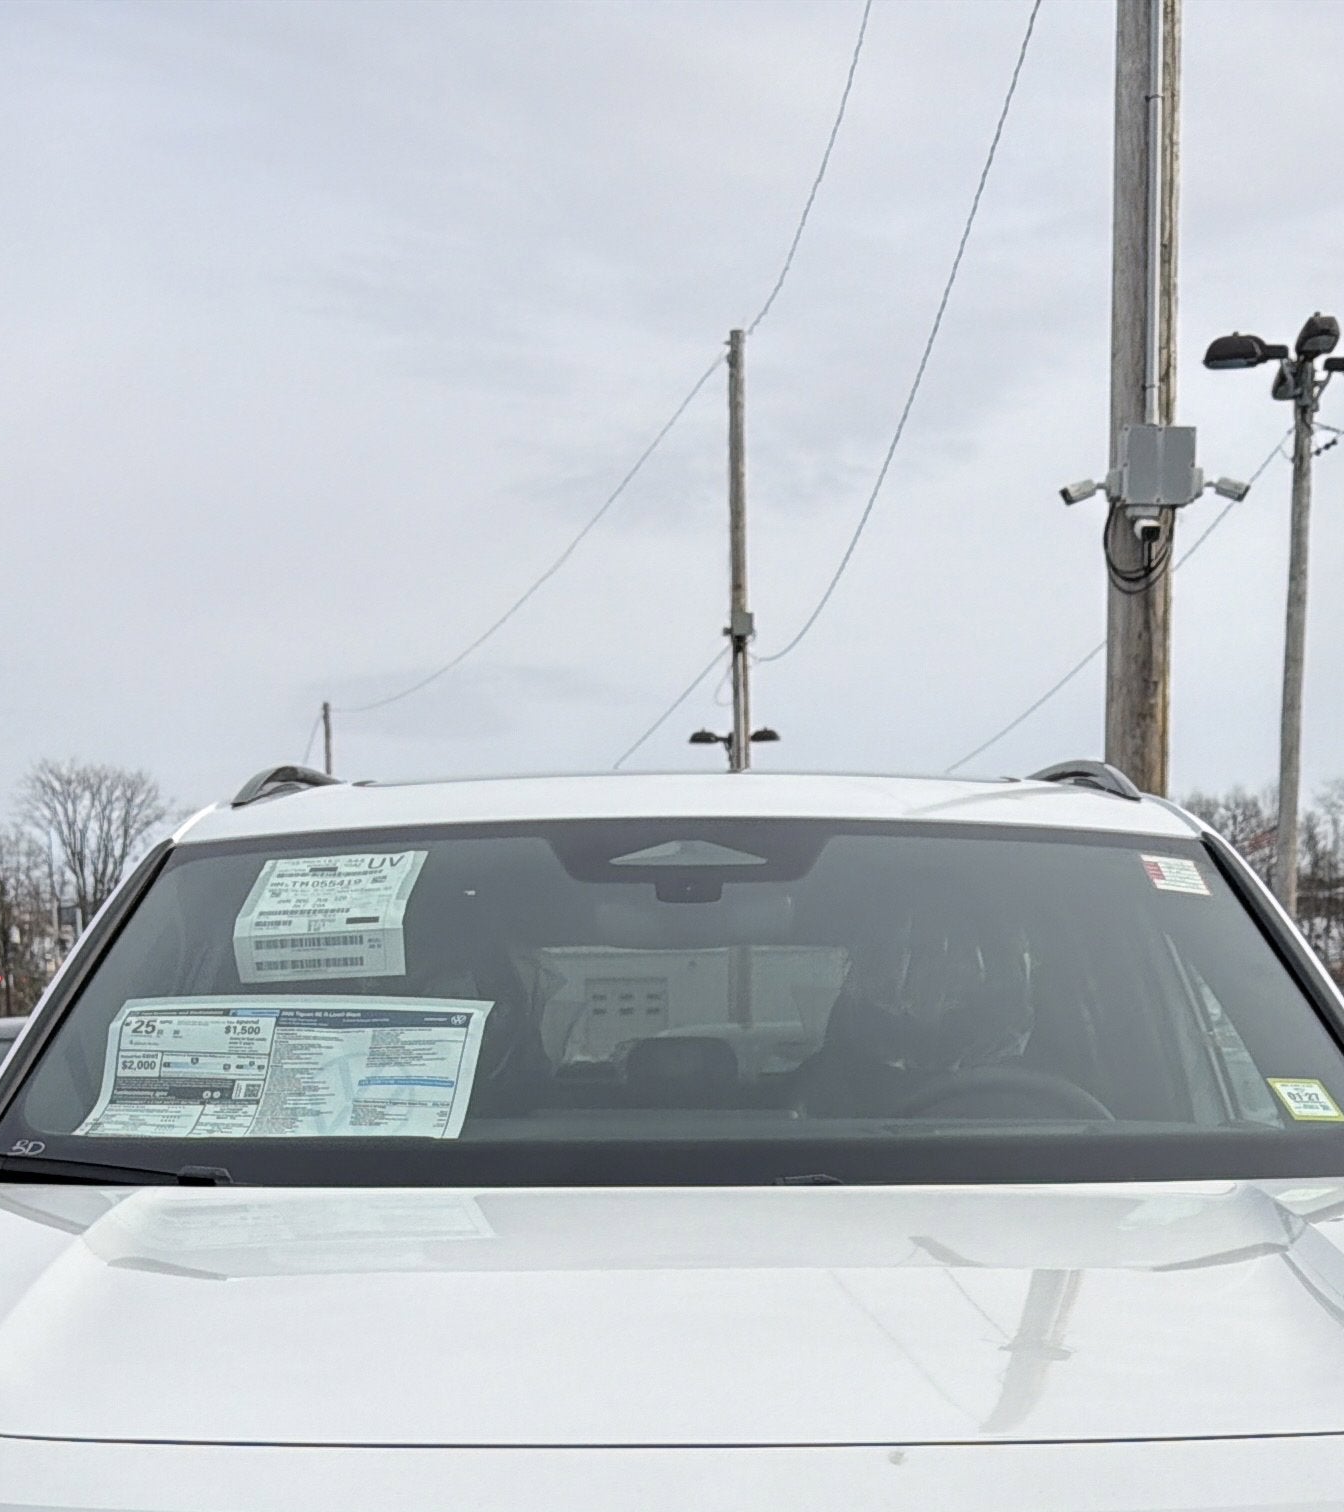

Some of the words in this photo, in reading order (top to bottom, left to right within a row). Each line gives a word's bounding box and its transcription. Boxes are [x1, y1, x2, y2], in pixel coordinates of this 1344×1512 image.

[367, 855, 405, 869] UV
[131, 1020, 157, 1034] 25
[224, 1025, 260, 1036] $1,500
[121, 1060, 156, 1070] $2,000
